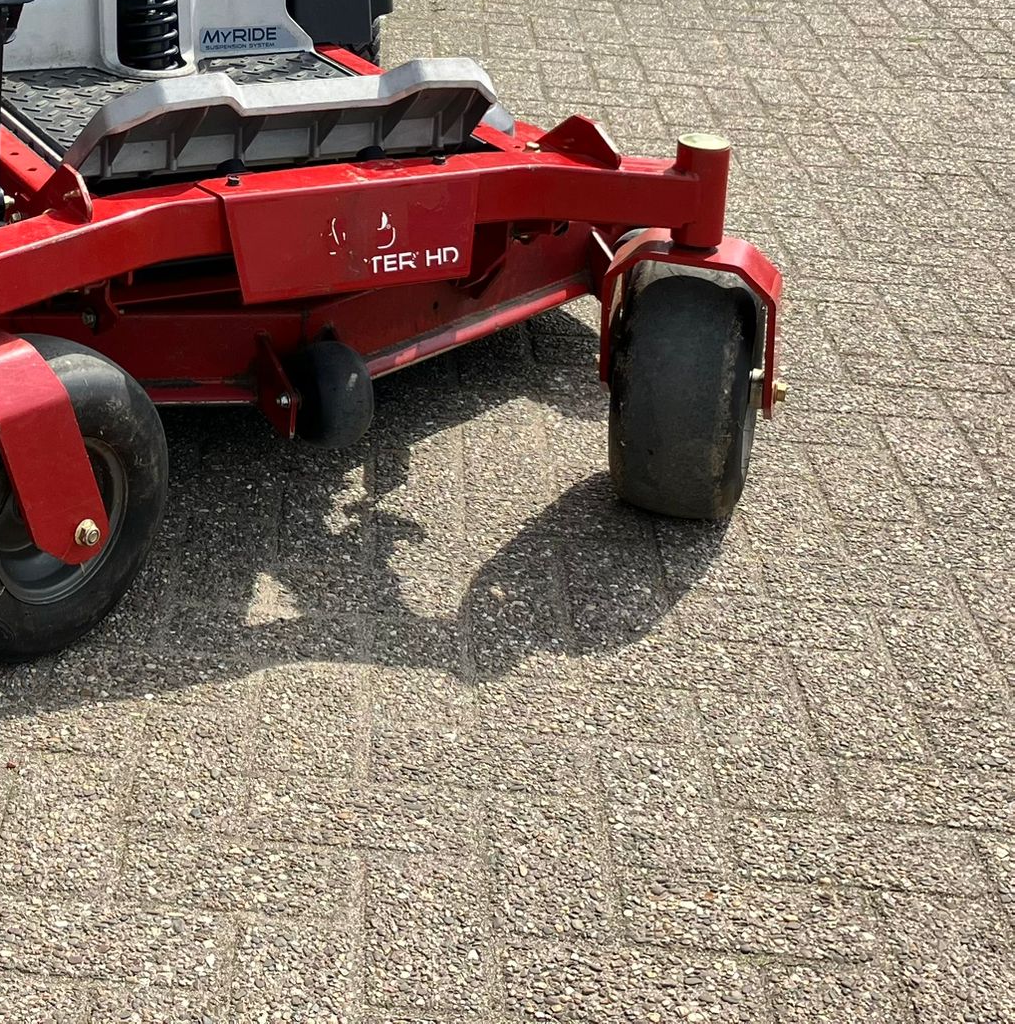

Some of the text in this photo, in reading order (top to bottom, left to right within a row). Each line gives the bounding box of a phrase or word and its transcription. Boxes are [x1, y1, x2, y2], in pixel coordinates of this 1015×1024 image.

[205, 42, 275, 51] SUSPENSION SYSTEM
[425, 246, 459, 267] HD
